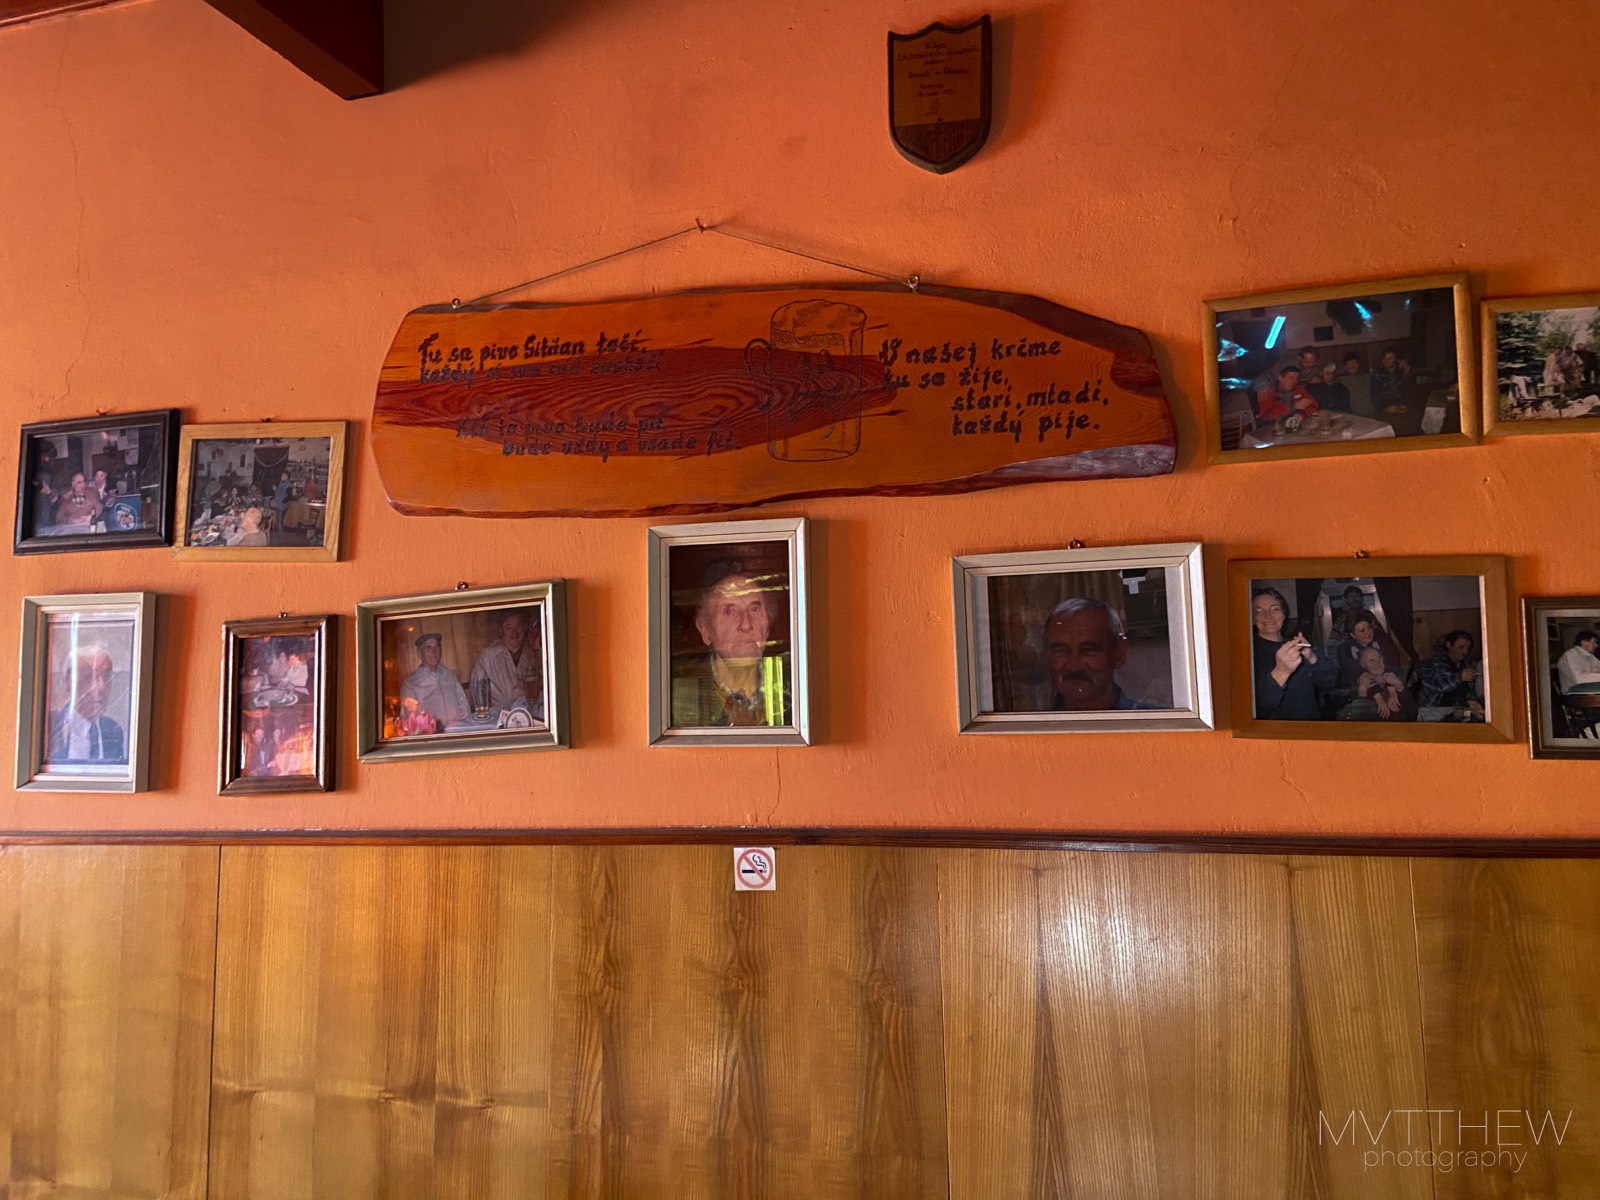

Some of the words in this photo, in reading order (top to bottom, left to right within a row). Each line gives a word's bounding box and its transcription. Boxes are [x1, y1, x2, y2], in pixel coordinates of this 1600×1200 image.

[419, 332, 443, 364] Tu
[447, 346, 474, 363] sa
[479, 340, 519, 371] pivo
[878, 337, 904, 366] V
[905, 341, 978, 369] našej
[991, 337, 1061, 357] krčme
[881, 367, 911, 394] tu
[918, 371, 945, 389] sa
[958, 366, 1010, 391] žije,
[952, 410, 1025, 443] každý
[1037, 409, 1101, 443] pije.
